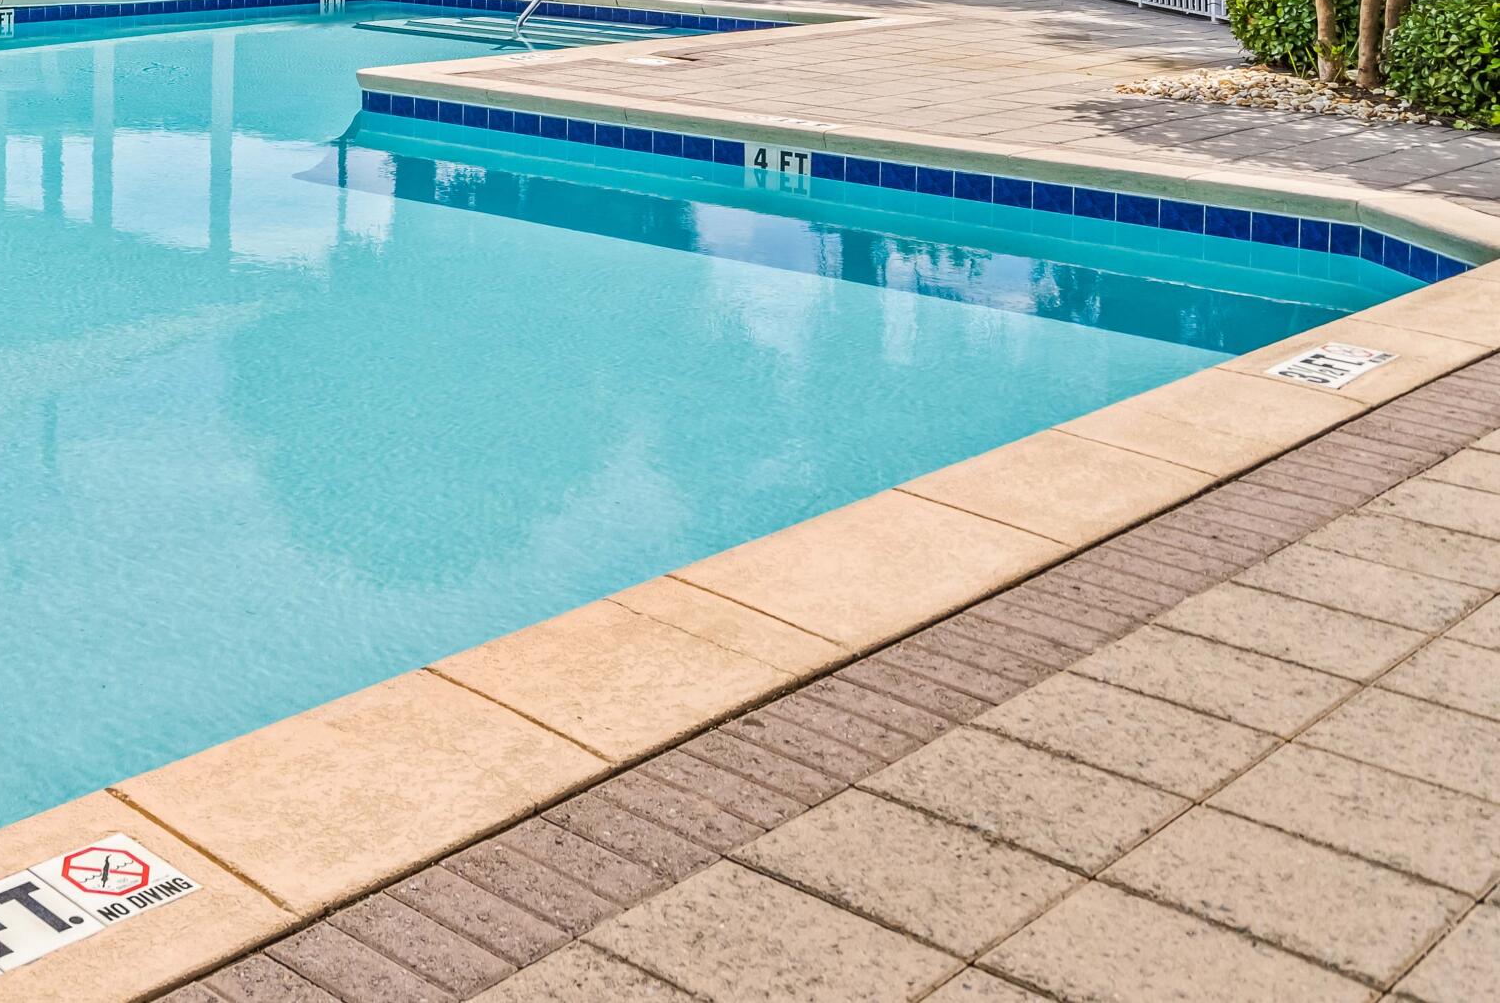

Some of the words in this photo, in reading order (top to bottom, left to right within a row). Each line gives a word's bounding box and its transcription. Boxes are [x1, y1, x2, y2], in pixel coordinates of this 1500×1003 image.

[0, 11, 13, 26] FT
[753, 147, 768, 170] 4
[97, 902, 131, 922] NO
[126, 877, 194, 909] DIVING
